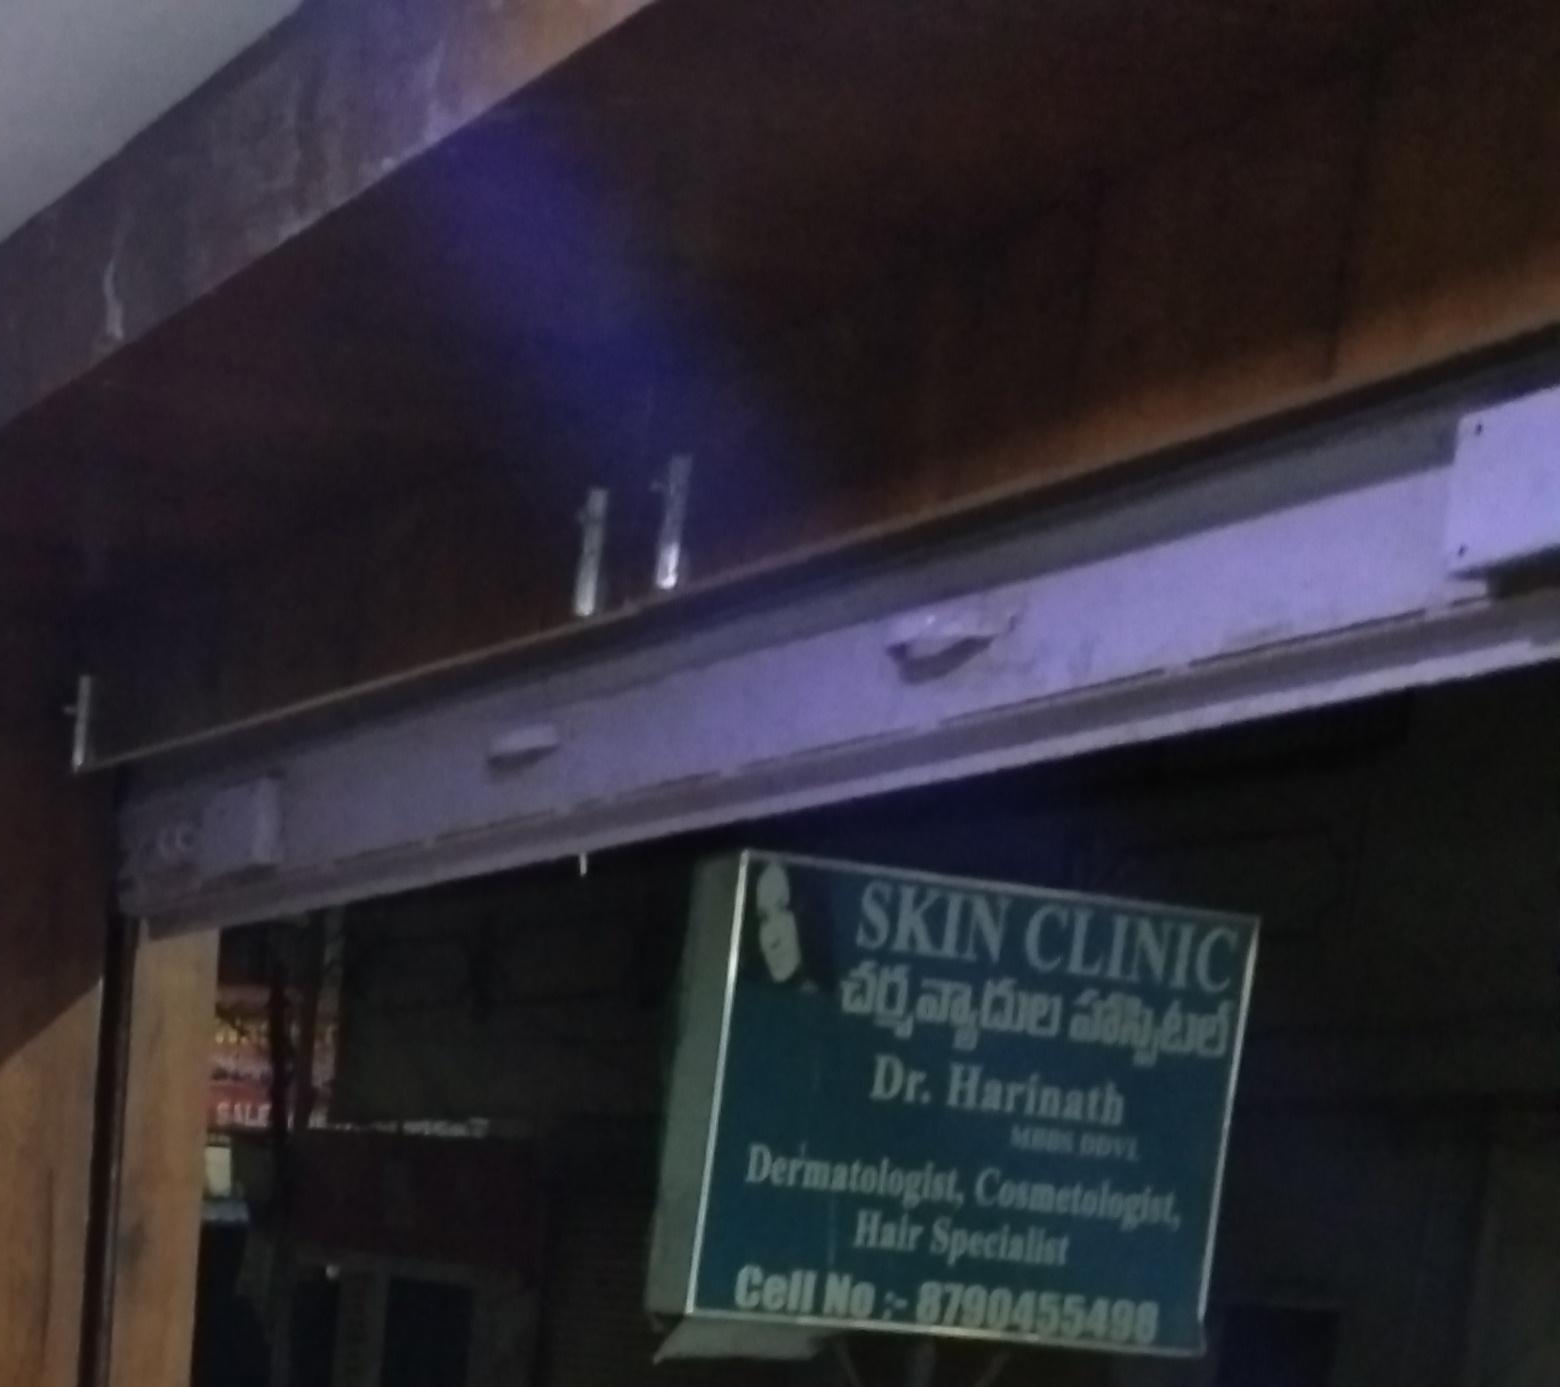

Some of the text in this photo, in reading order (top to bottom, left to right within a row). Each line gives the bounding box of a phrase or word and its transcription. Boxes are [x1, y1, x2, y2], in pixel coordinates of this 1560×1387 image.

[856, 879, 1239, 993] SKIN CLINIC
[870, 1053, 1125, 1128] Dr. Harinath
[745, 1143, 1183, 1232] Dermatologist, Cosmetologist,
[852, 1210, 1070, 1267] Hair Specialist
[734, 1263, 817, 1313] Cell
[821, 1271, 876, 1319] No
